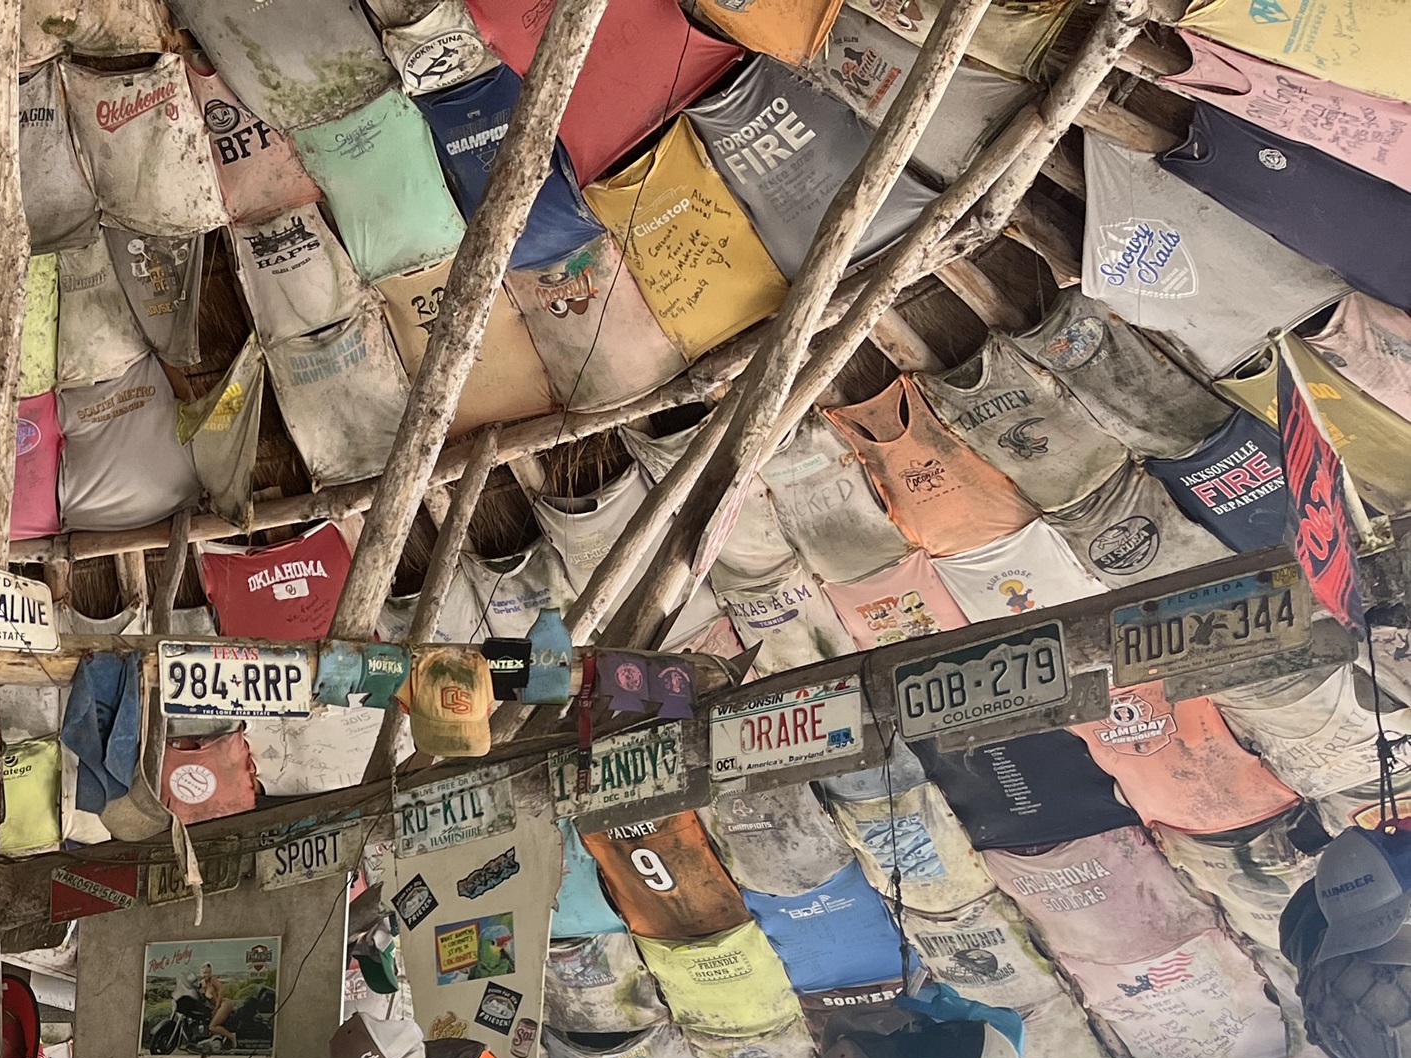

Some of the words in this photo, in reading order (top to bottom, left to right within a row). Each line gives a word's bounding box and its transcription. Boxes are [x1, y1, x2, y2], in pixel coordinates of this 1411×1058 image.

[438, 34, 463, 46] TUNA
[96, 80, 178, 131] Oklahoma
[713, 97, 789, 155] TORONTO
[725, 111, 817, 186] FIRE
[634, 197, 690, 239] Clickstop
[255, 239, 321, 270] HAP'S
[1099, 222, 1152, 287] Snowy
[1137, 228, 1181, 286] Trails
[959, 389, 1032, 432] LAKEVIEW
[1180, 440, 1259, 487] JACKSONVILLE
[1191, 452, 1283, 507] FIRE
[247, 560, 327, 592] OKLAHOMA
[986, 573, 1001, 592] BLUE
[1002, 569, 1033, 581] GOOSE
[772, 595, 784, 611] A
[783, 591, 795, 605] &
[794, 584, 813, 602] M
[1166, 580, 1244, 606] FLORIDA
[1232, 590, 1295, 640] 344
[210, 646, 260, 661] TEXAS
[168, 661, 229, 700] 984
[243, 663, 302, 702] RRP
[990, 646, 1056, 696] 279
[717, 692, 785, 716] WISCONSIN
[904, 671, 967, 719] GOB
[942, 695, 1025, 725] COLORADO
[739, 702, 827, 756] ORARE
[1099, 719, 1168, 743] GAMEDAY
[1112, 729, 1163, 744] FIREHOUSE
[716, 757, 736, 771] OCT
[746, 755, 784, 771] America's
[788, 749, 825, 764] Dairyland
[419, 785, 436, 798] LIVE
[437, 781, 457, 793] FREE
[458, 777, 470, 787] OR
[429, 826, 484, 848] HAMPSHIRE
[606, 821, 658, 841] PALMER
[727, 818, 772, 833] CHAMPIONS
[275, 832, 341, 876] SPORT
[630, 848, 676, 892] 9
[1012, 857, 1111, 897] OKLAHOMA
[1041, 886, 1107, 913] SOONERS
[694, 967, 728, 981] SIGNS
[697, 955, 739, 971] FRIENDLY
